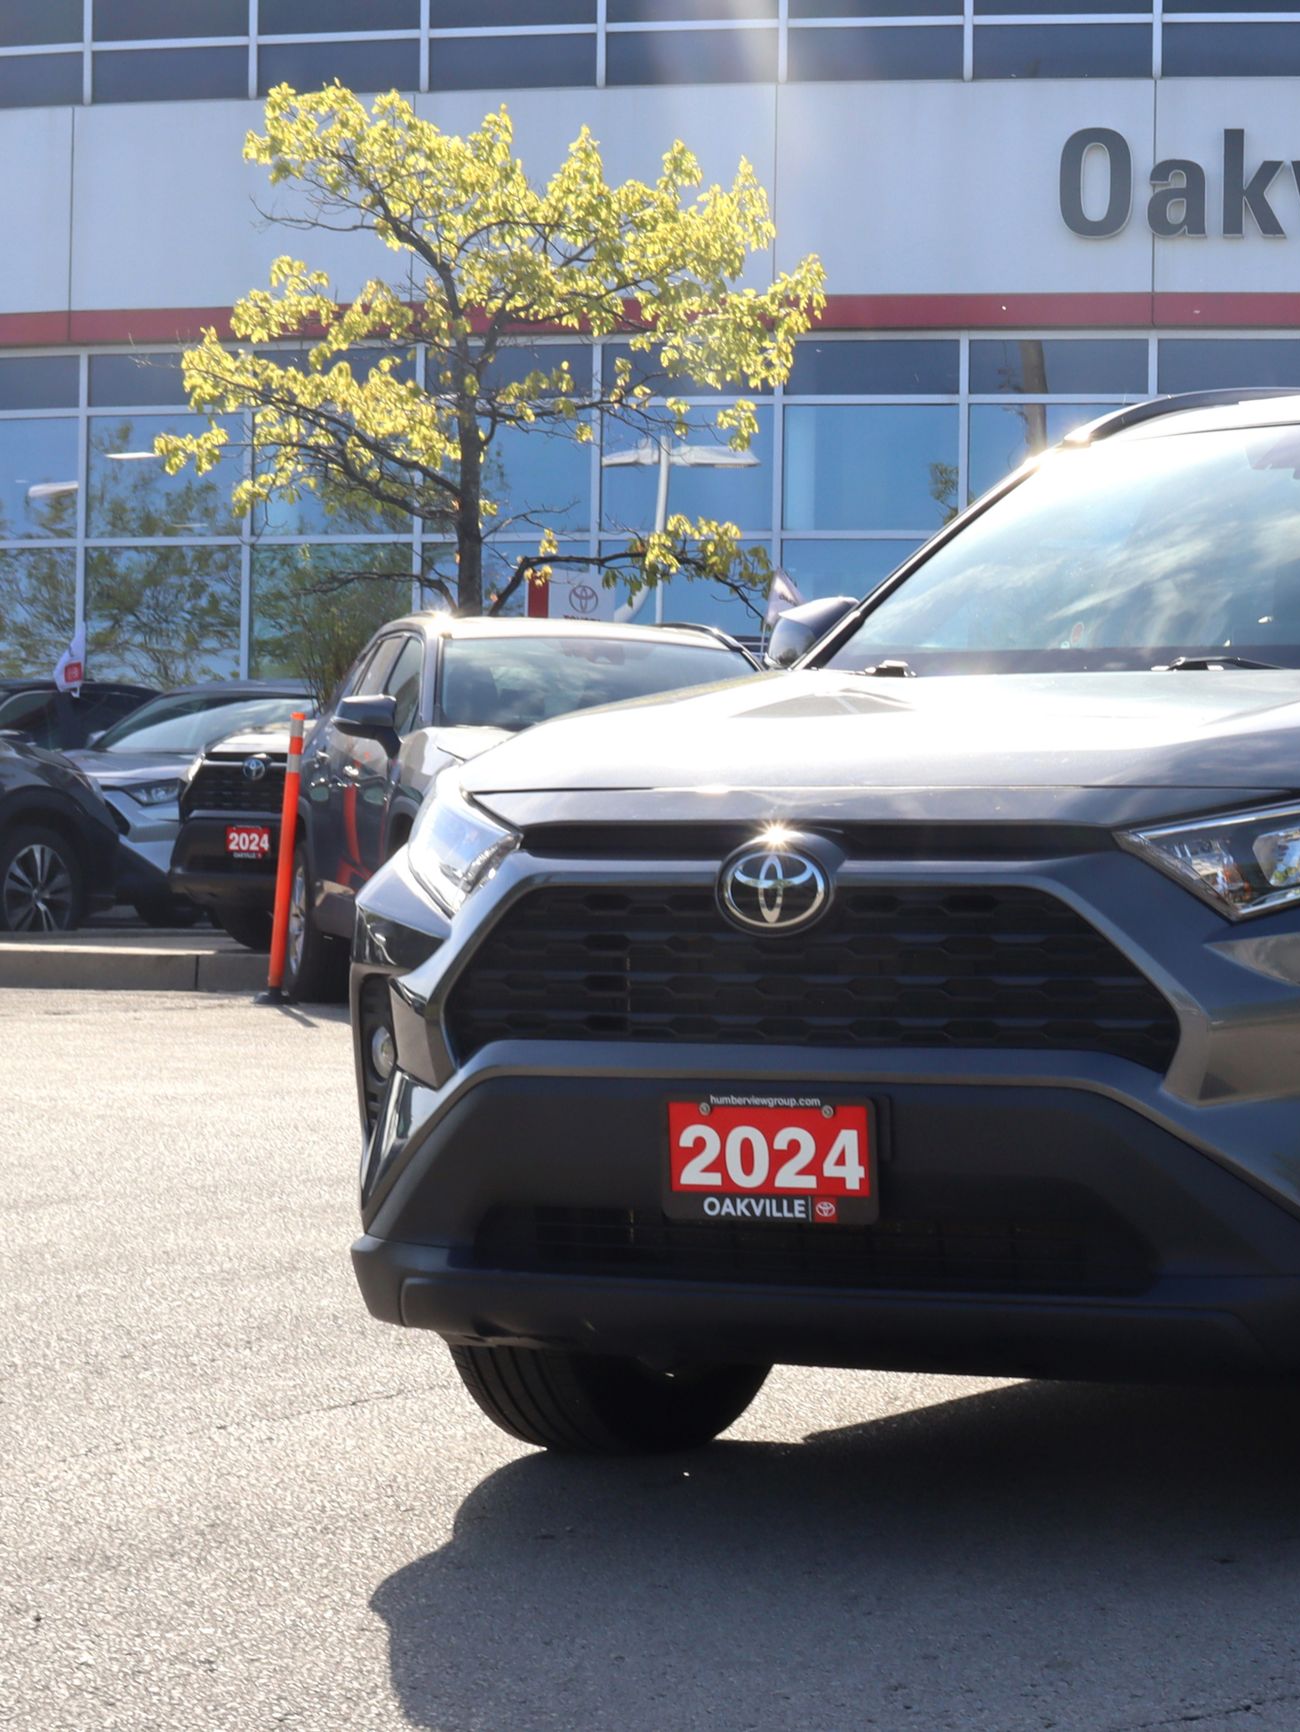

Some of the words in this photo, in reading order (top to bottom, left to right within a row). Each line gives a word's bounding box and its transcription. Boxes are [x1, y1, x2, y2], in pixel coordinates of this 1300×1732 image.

[229, 832, 270, 851] 2024
[710, 1094, 821, 1108] humberviewgroup.com
[678, 1124, 865, 1190] 2024
[703, 1196, 807, 1218] OAKVILLE
